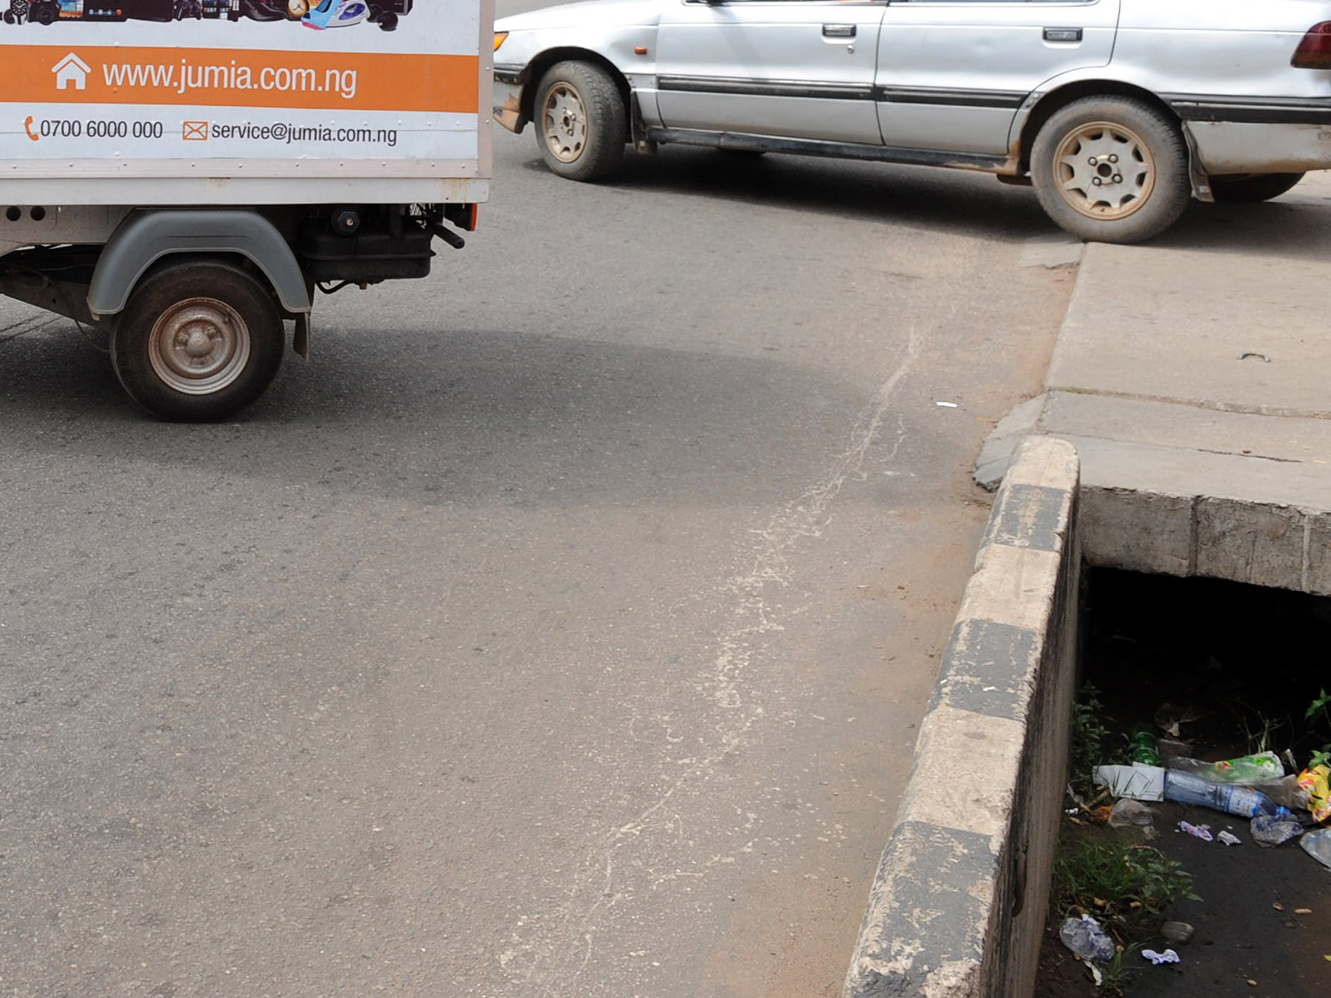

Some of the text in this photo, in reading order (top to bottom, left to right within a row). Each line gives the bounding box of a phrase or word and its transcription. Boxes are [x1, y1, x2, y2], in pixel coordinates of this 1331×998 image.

[102, 59, 358, 99] www.jumia.com.ng
[39, 119, 164, 140] 0700 6000 000
[211, 121, 398, 147] service@jumia.com.ng
